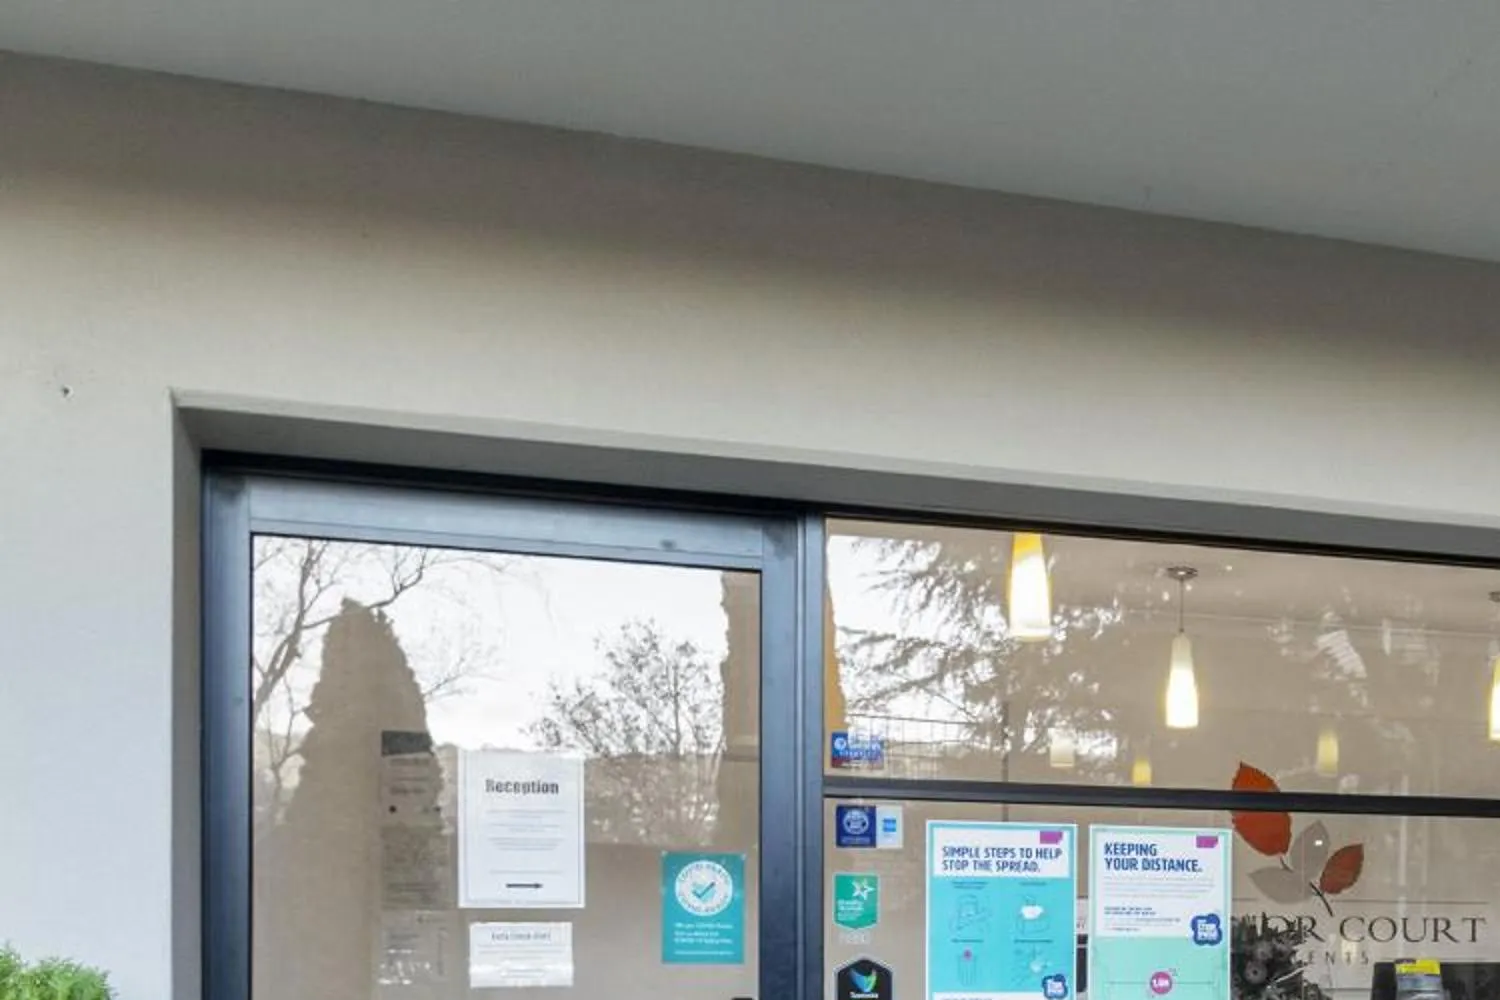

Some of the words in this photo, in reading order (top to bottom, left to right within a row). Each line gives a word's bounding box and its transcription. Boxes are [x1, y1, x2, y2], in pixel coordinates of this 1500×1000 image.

[485, 779, 560, 794] Reception
[942, 846, 980, 859] SIMPLE
[984, 847, 1016, 859] STEPS
[1020, 848, 1033, 859] TO
[1036, 848, 1063, 860] HELP
[1104, 842, 1157, 856] KEEPING
[942, 860, 969, 871] STOP
[973, 860, 993, 871] THE
[1104, 858, 1139, 870] YOUR
[1141, 858, 1203, 872] DISTANCE.
[1339, 916, 1488, 943] COURT
